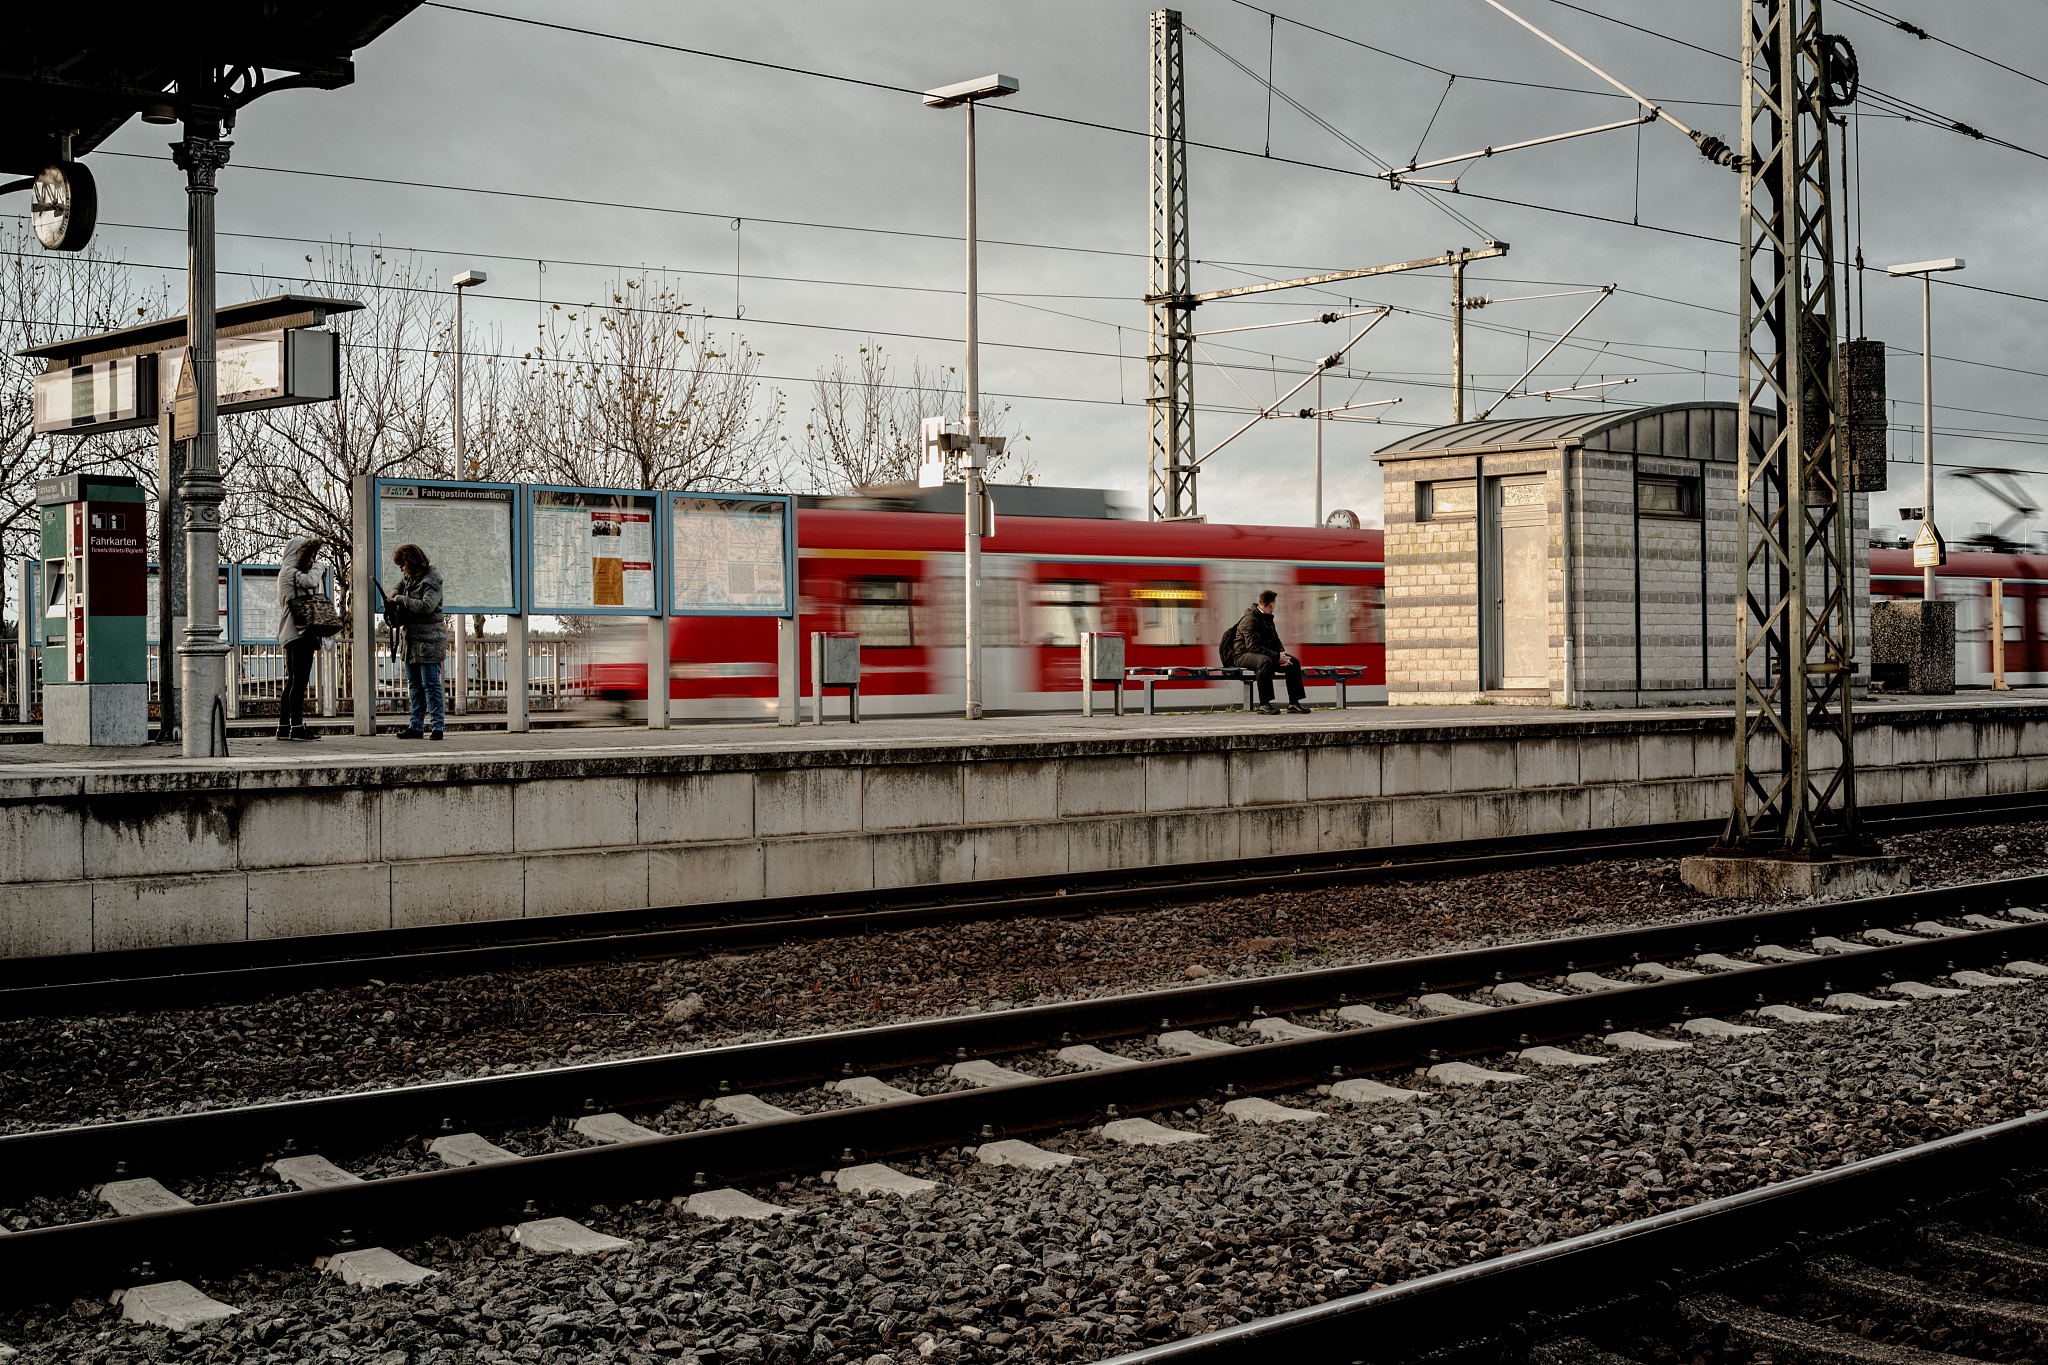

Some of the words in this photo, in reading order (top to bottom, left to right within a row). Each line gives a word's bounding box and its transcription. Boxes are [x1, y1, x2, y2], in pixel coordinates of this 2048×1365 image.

[926, 422, 942, 464] H
[38, 484, 58, 494] Fahrkarten
[422, 488, 506, 500] Fahrgastinformation
[90, 536, 137, 546] Fahrkarten
